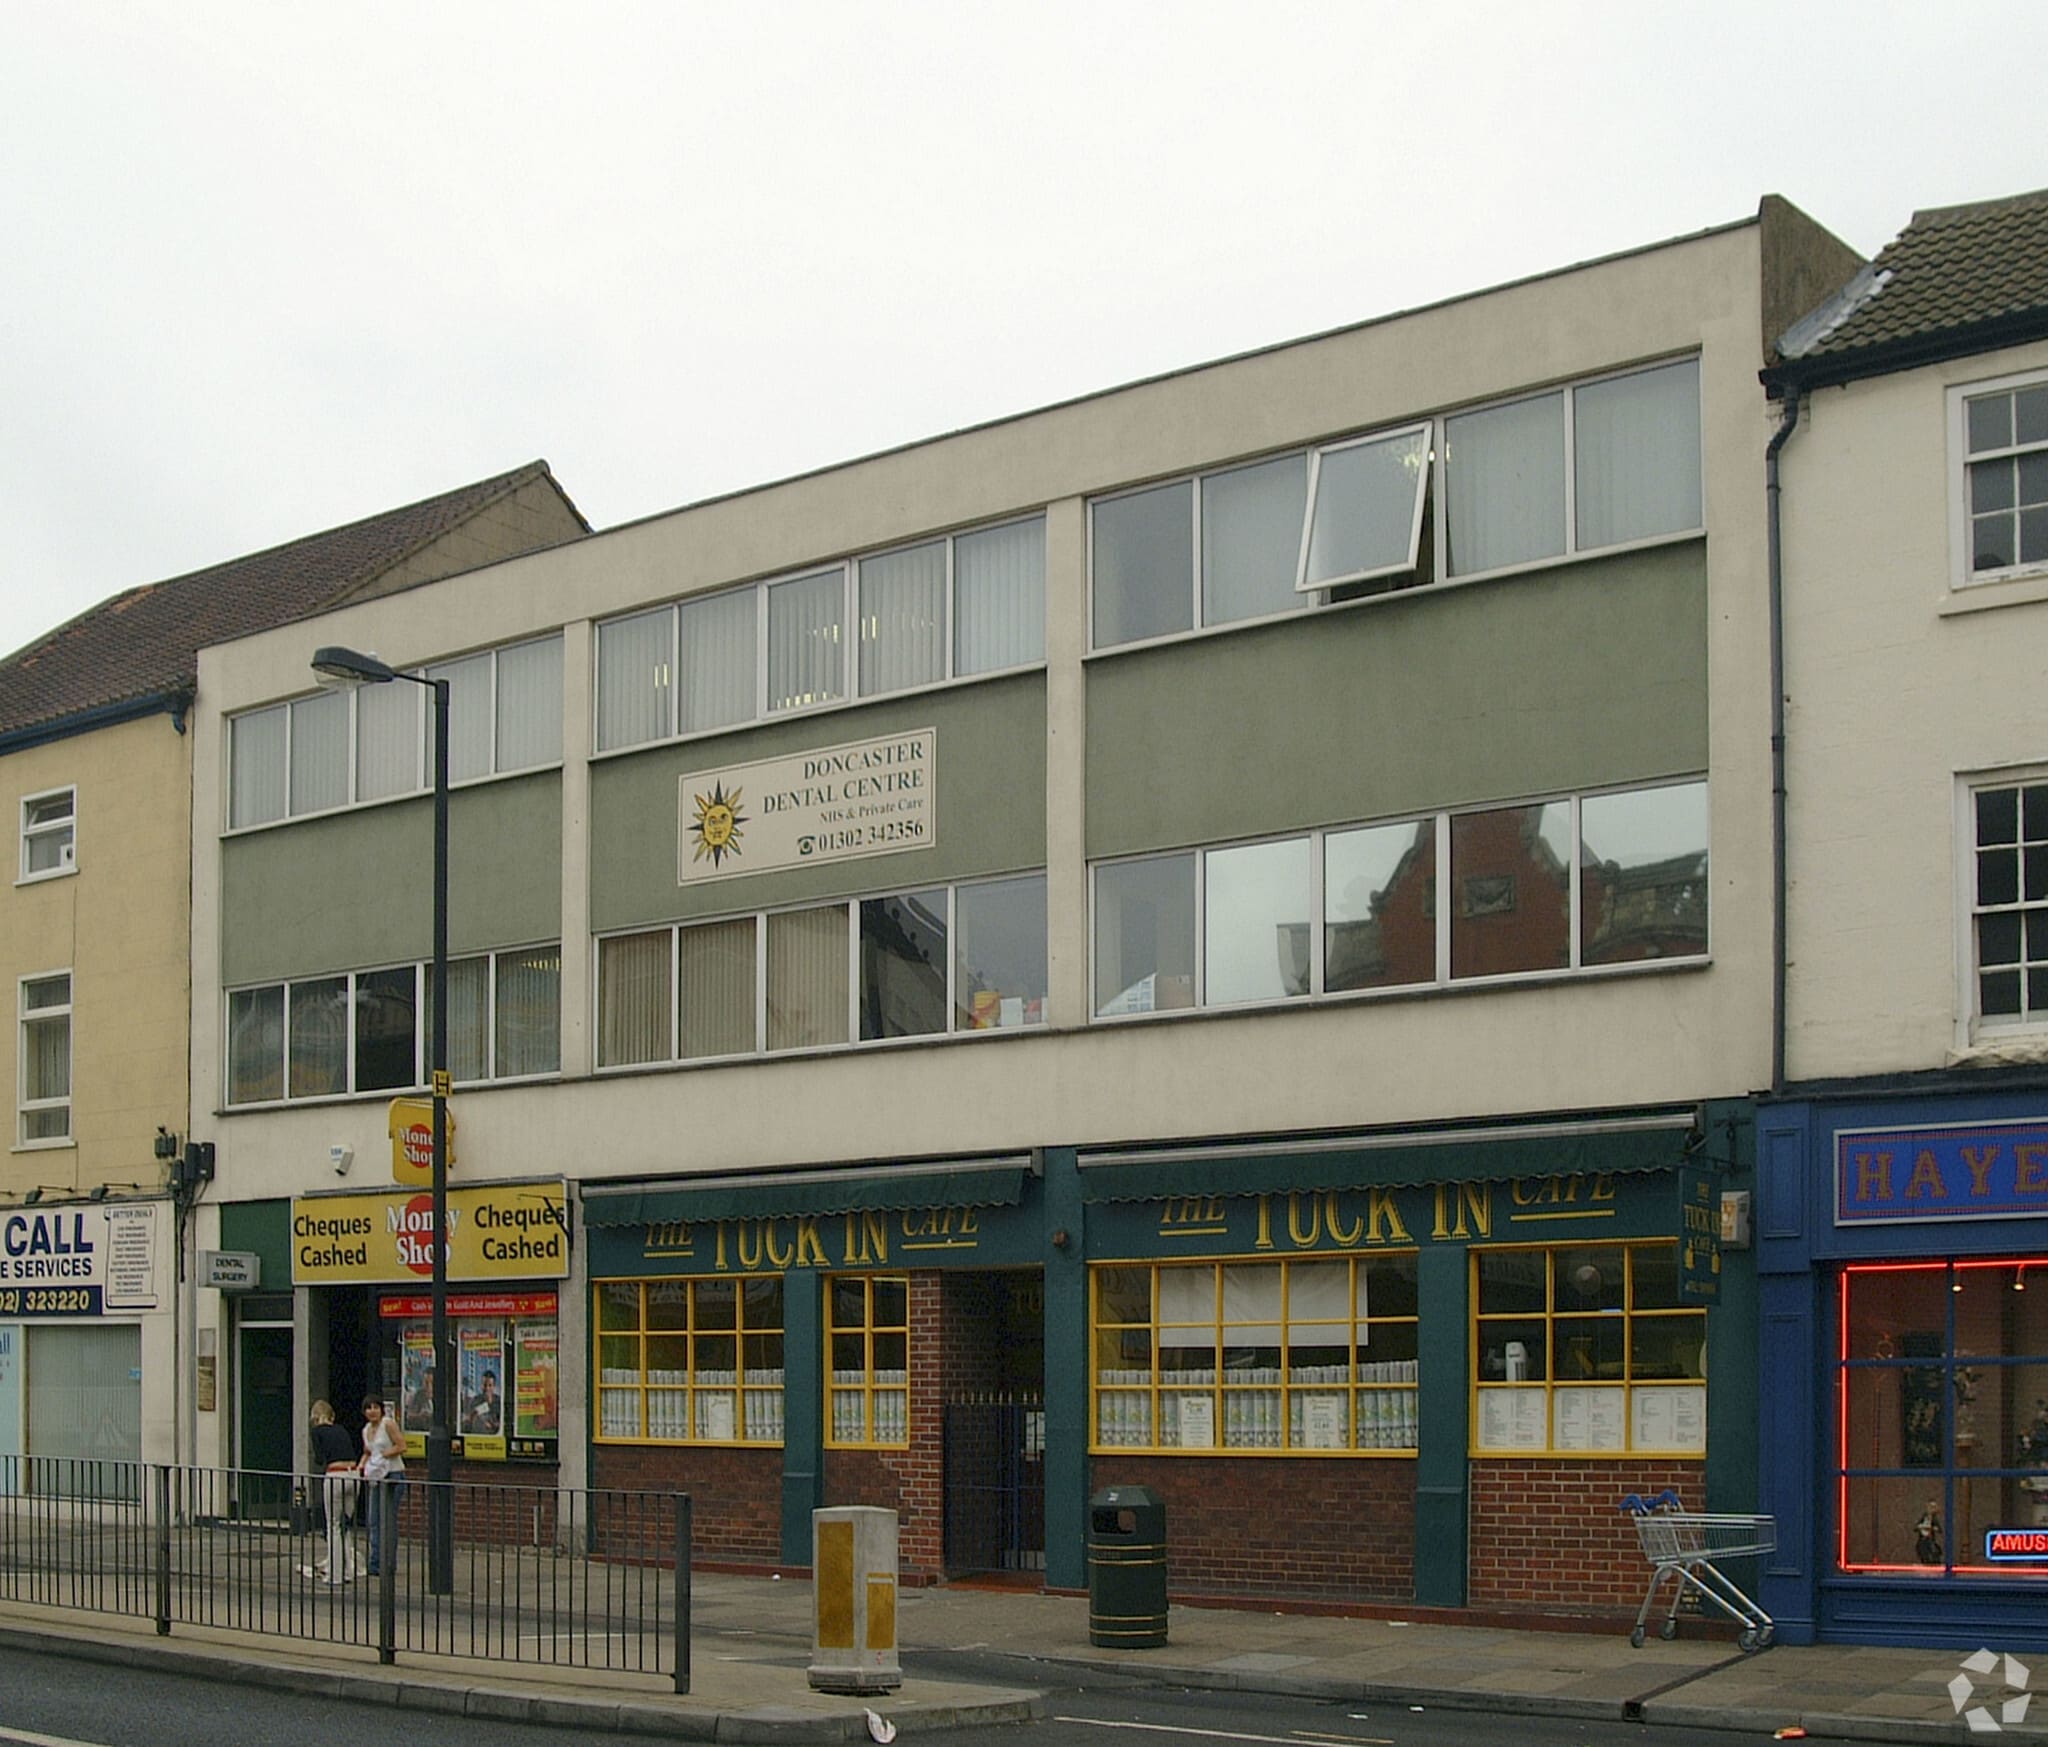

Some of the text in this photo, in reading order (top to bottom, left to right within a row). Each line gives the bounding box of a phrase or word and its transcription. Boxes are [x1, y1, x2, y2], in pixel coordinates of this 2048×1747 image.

[803, 741, 923, 780] DONCASTER
[764, 769, 924, 814] DENTAL CENTRE
[819, 798, 923, 825] NHS & Private Care
[819, 820, 923, 852] 01302 342356
[294, 1204, 565, 1240] Cheques Mony Cheques
[1255, 1190, 1414, 1248] TUCK
[1432, 1182, 1492, 1241] IN
[5, 1213, 94, 1257] CALL
[300, 1244, 367, 1267] Cashed
[482, 1234, 559, 1260] Cashed
[715, 1217, 831, 1270] TUCK
[843, 1209, 888, 1265] IN
[14, 1258, 92, 1278] SERVICES
[212, 1271, 247, 1282] SURGERY
[216, 1258, 244, 1268] DENTAL
[25, 1289, 90, 1311] 323220
[1992, 1533, 2048, 1551] AMUS
